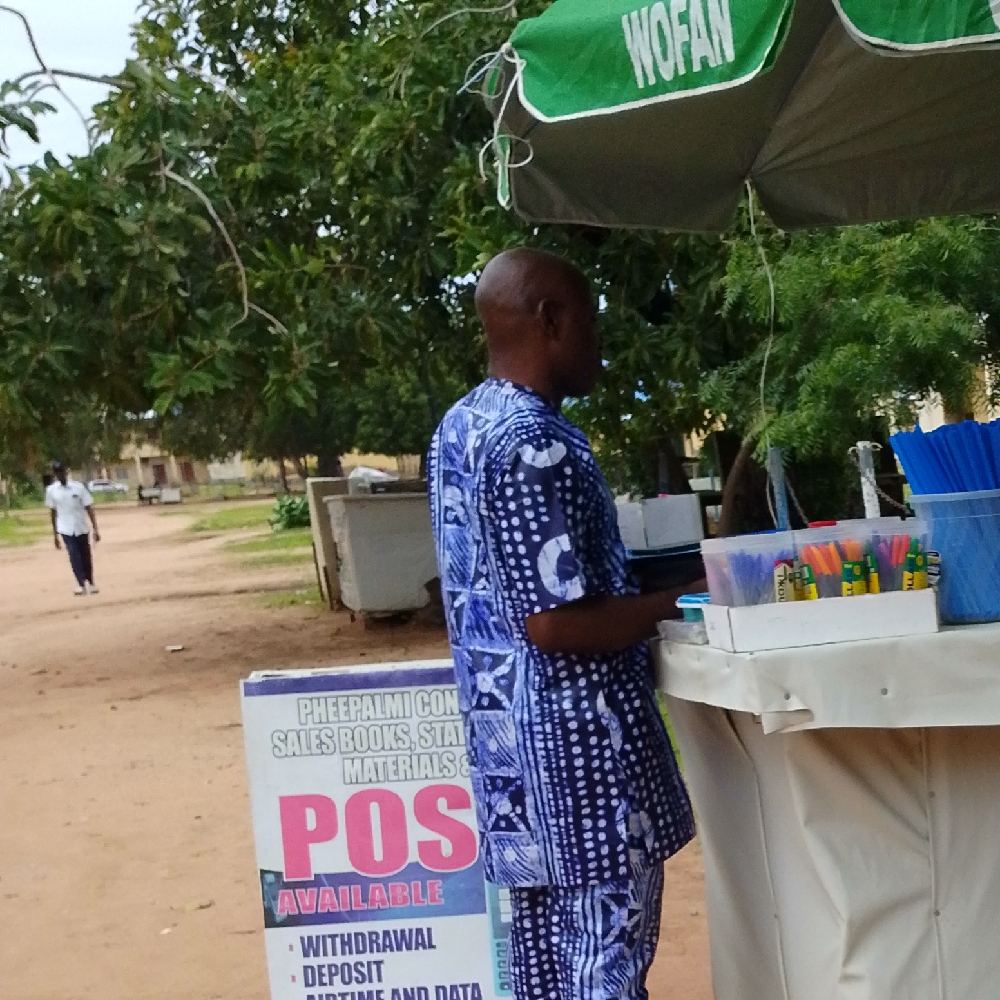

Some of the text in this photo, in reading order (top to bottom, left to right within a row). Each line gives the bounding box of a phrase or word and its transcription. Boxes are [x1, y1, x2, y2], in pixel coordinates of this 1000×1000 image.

[621, 0, 736, 89] WOFAN
[298, 691, 412, 726] PHEEPALMI
[271, 726, 336, 758] SALES
[338, 722, 417, 755] BOOKS,
[342, 751, 458, 785] MATERIALS
[278, 784, 480, 882] POS
[277, 880, 445, 916] AVAILABLE
[299, 927, 437, 958] WITHDRAWAL
[302, 960, 384, 988] DEPOSIT
